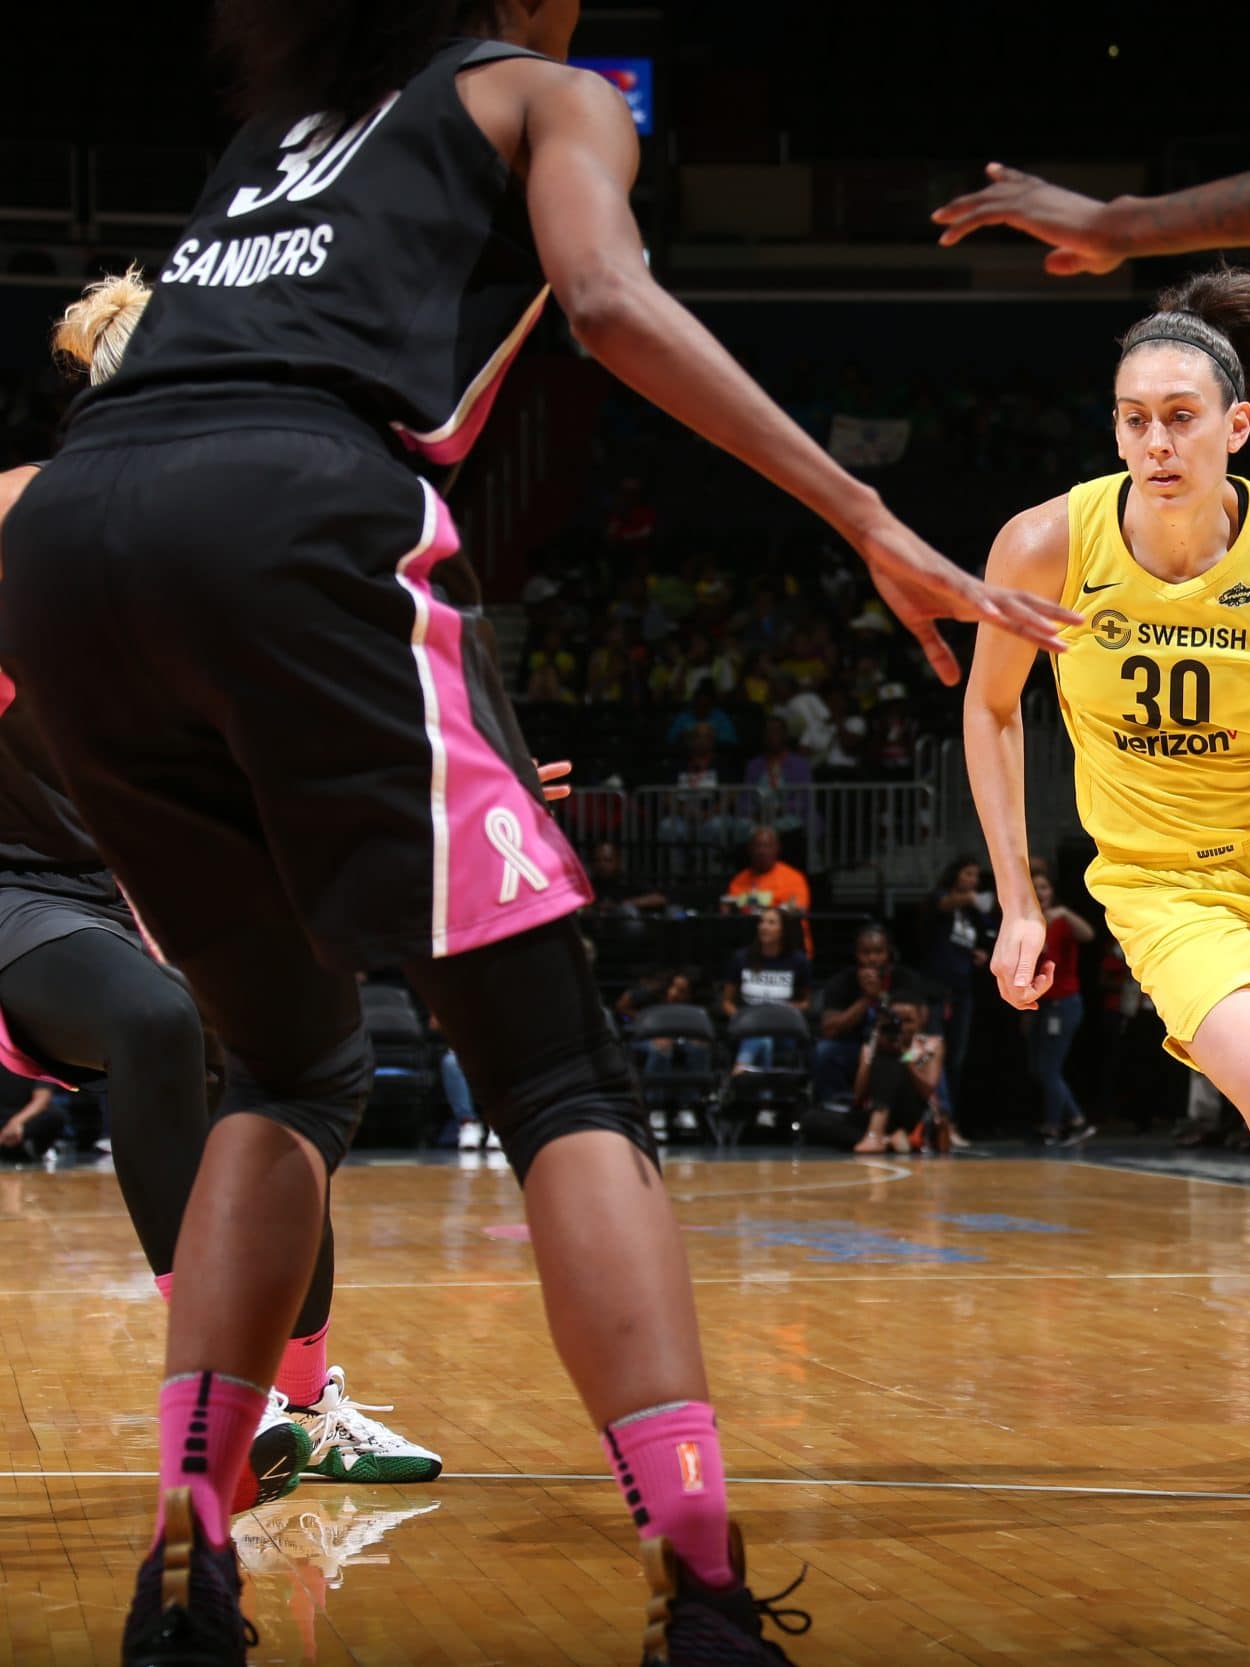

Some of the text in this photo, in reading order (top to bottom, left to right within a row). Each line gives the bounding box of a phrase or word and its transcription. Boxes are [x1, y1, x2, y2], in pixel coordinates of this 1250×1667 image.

[227, 90, 401, 217] 30
[161, 223, 333, 287] SANDERS
[1137, 624, 1247, 650] SWEDISH
[1120, 655, 1211, 730] 30
[1113, 730, 1230, 757] verizon
